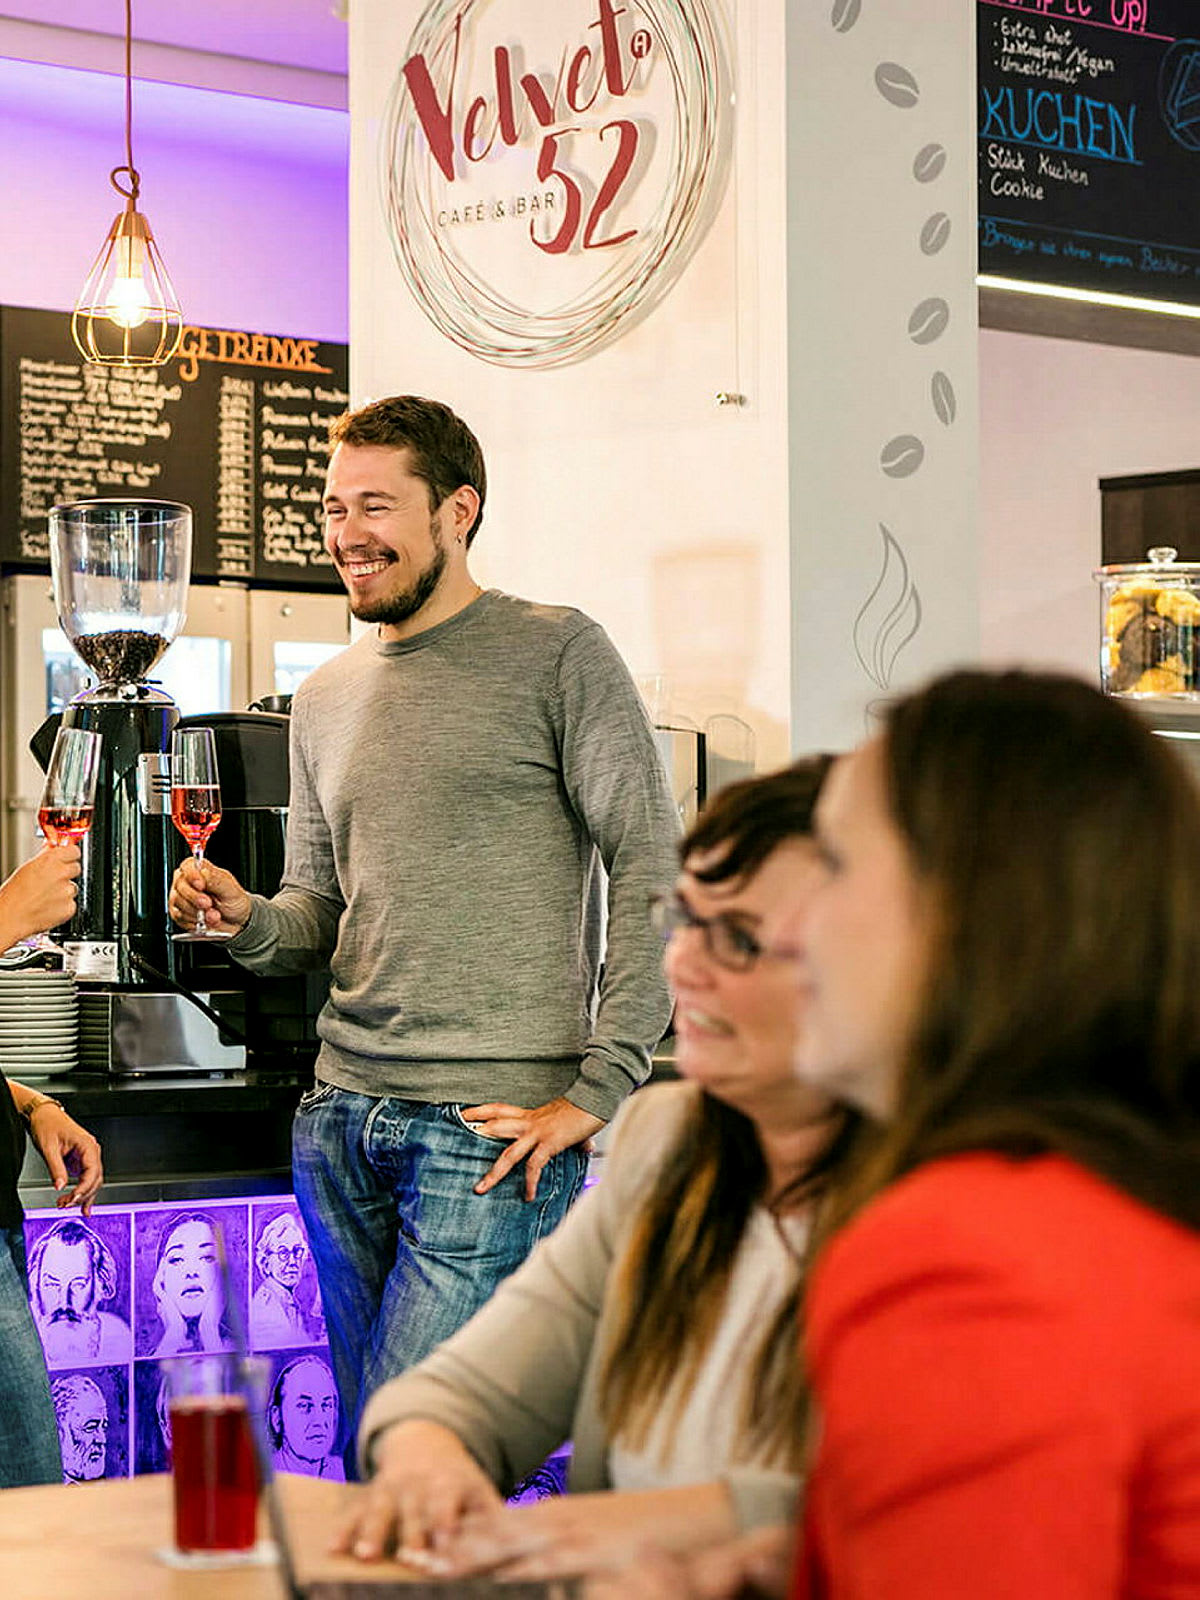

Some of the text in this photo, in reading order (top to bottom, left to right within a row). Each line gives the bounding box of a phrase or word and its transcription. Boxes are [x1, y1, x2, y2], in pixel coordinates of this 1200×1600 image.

[402, 0, 628, 181] Velvet
[982, 87, 1137, 161] KUCHEN
[531, 119, 639, 254] 52
[990, 172, 1044, 200] Cookie
[1038, 153, 1089, 186] Kuchen
[437, 191, 555, 228] CAFÉ & BAR
